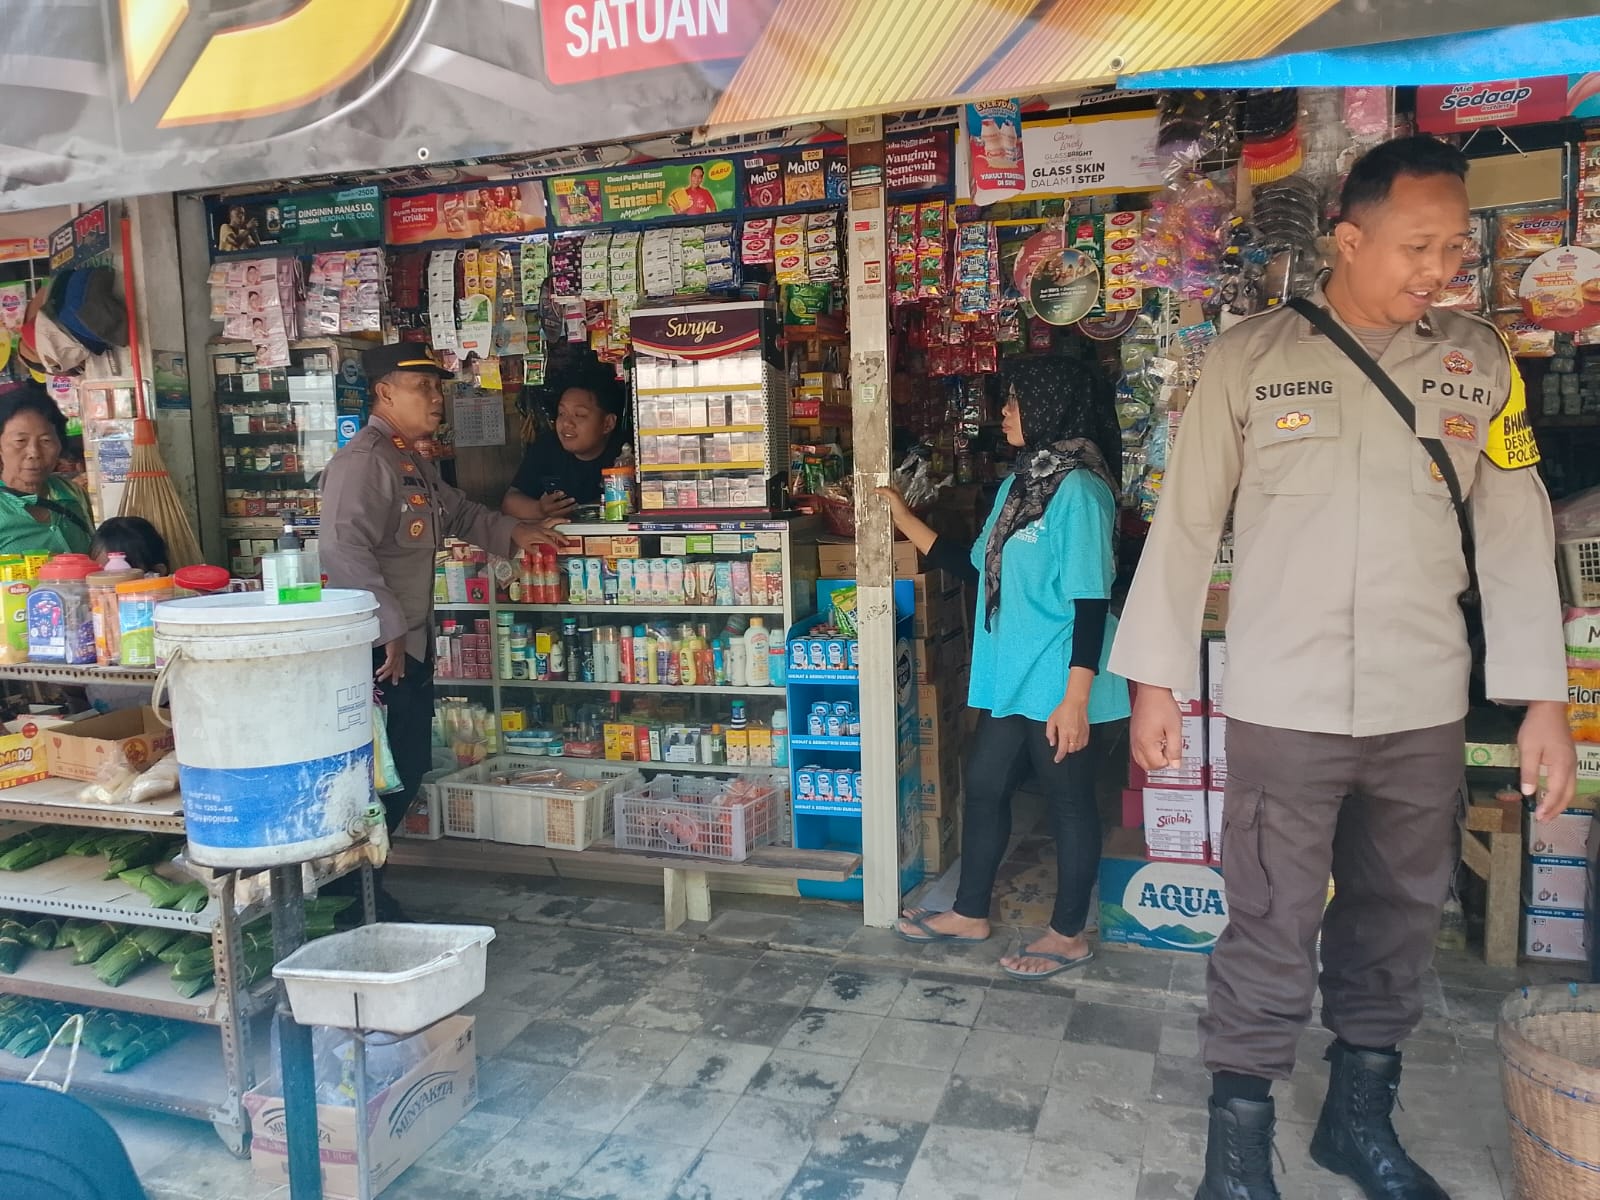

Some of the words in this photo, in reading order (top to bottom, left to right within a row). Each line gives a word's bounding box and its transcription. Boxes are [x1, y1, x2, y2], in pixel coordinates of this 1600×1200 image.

[564, 0, 728, 58] SATUAN
[1453, 85, 1473, 94] Mie
[1441, 87, 1531, 110] Sedaap
[886, 149, 938, 165] Wanginya
[787, 160, 820, 175] Molto
[886, 159, 936, 177] Semewah
[1032, 165, 1073, 178] GLASS
[1075, 162, 1106, 174] SKIN
[750, 170, 778, 185] Molto
[886, 174, 937, 189] Perhiasan
[1031, 177, 1069, 188] DALAM
[1071, 176, 1076, 184] 1
[1078, 174, 1106, 184] STEP
[631, 180, 666, 192] Pulang
[609, 191, 663, 209] Emas!
[298, 208, 333, 219] DINGININ
[334, 204, 360, 215] PANAS
[584, 250, 607, 259] CLEAR
[612, 250, 634, 259] CLEAR
[584, 271, 607, 280] CLEAR
[613, 272, 635, 281] CLEAR
[665, 317, 724, 343] Surya
[1255, 380, 1334, 402] SUGENG
[1421, 378, 1492, 406] POLRI
[1138, 882, 1226, 918] AQUA
[394, 1081, 455, 1139] MINYAKITA
